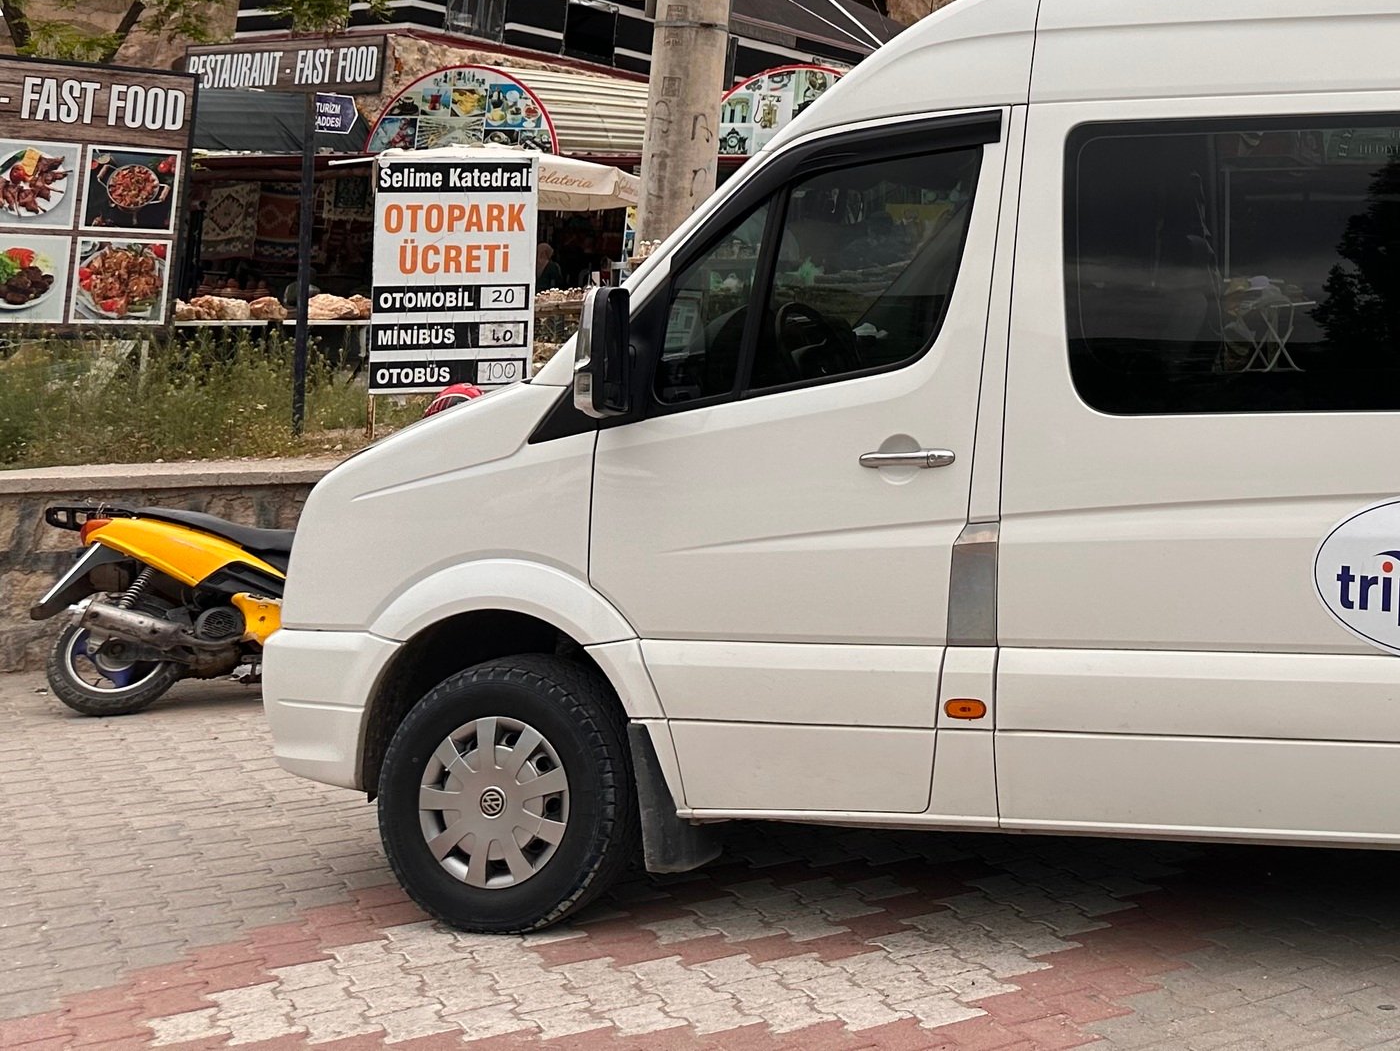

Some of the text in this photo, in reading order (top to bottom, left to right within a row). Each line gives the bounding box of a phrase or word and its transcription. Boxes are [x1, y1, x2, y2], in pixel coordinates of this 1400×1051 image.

[294, 49, 334, 85] FAST
[336, 46, 378, 83] FOOD
[20, 76, 187, 131] FAST FOOD
[315, 115, 342, 128] ADDESİ
[380, 167, 533, 188] Selime Katedrali
[384, 203, 526, 234] OTOPARK
[379, 287, 515, 308] OTOMOBİL 20
[377, 324, 513, 346] MİNİBÜS 40
[376, 361, 517, 385] OTOBÜS 100
